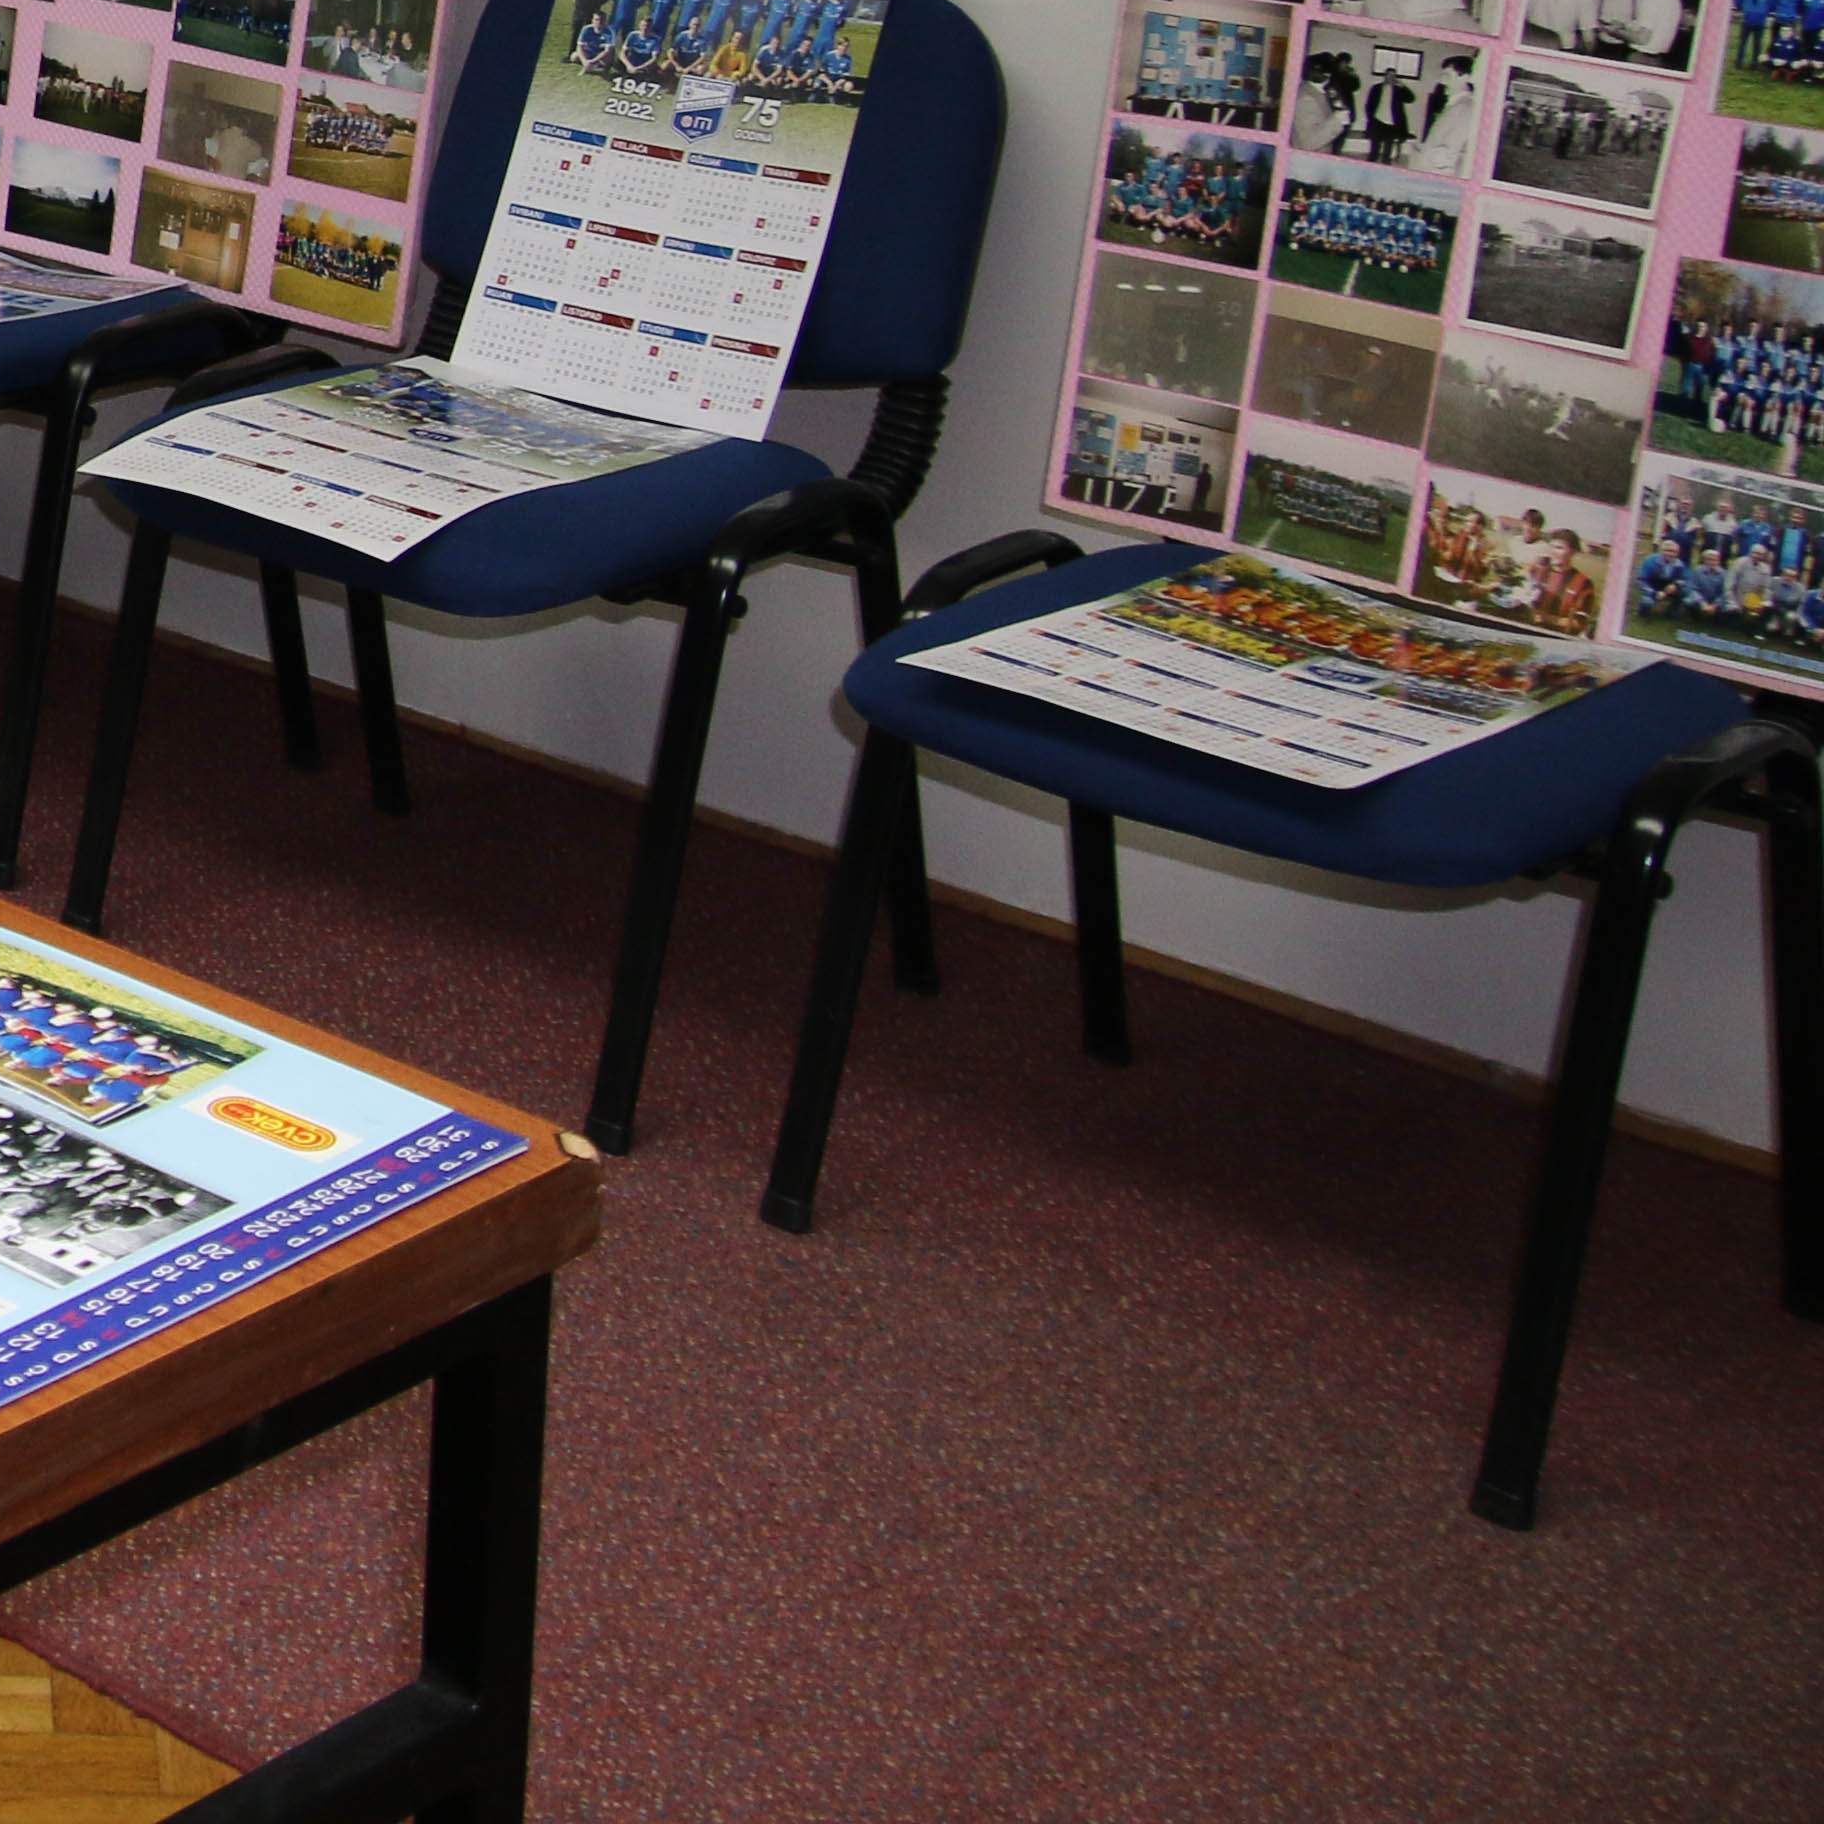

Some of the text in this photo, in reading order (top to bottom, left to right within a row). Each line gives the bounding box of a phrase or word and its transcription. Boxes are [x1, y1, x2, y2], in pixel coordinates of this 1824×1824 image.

[611, 78, 661, 100] 1947.
[605, 98, 655, 120] 2022.
[741, 96, 781, 127] 75
[734, 128, 773, 143] GODINA
[613, 139, 648, 154] VELJAČA
[589, 223, 616, 235] LIPANJ
[665, 239, 695, 251] SRPANJ
[564, 305, 602, 322] LISTOPAD
[640, 321, 674, 336] STUDENI
[435, 1124, 473, 1141] 31
[284, 1197, 325, 1216] 24
[240, 1219, 282, 1238] 22
[171, 1252, 212, 1271] 19
[124, 1274, 166, 1294] 17
[6, 1332, 46, 1352] 12
